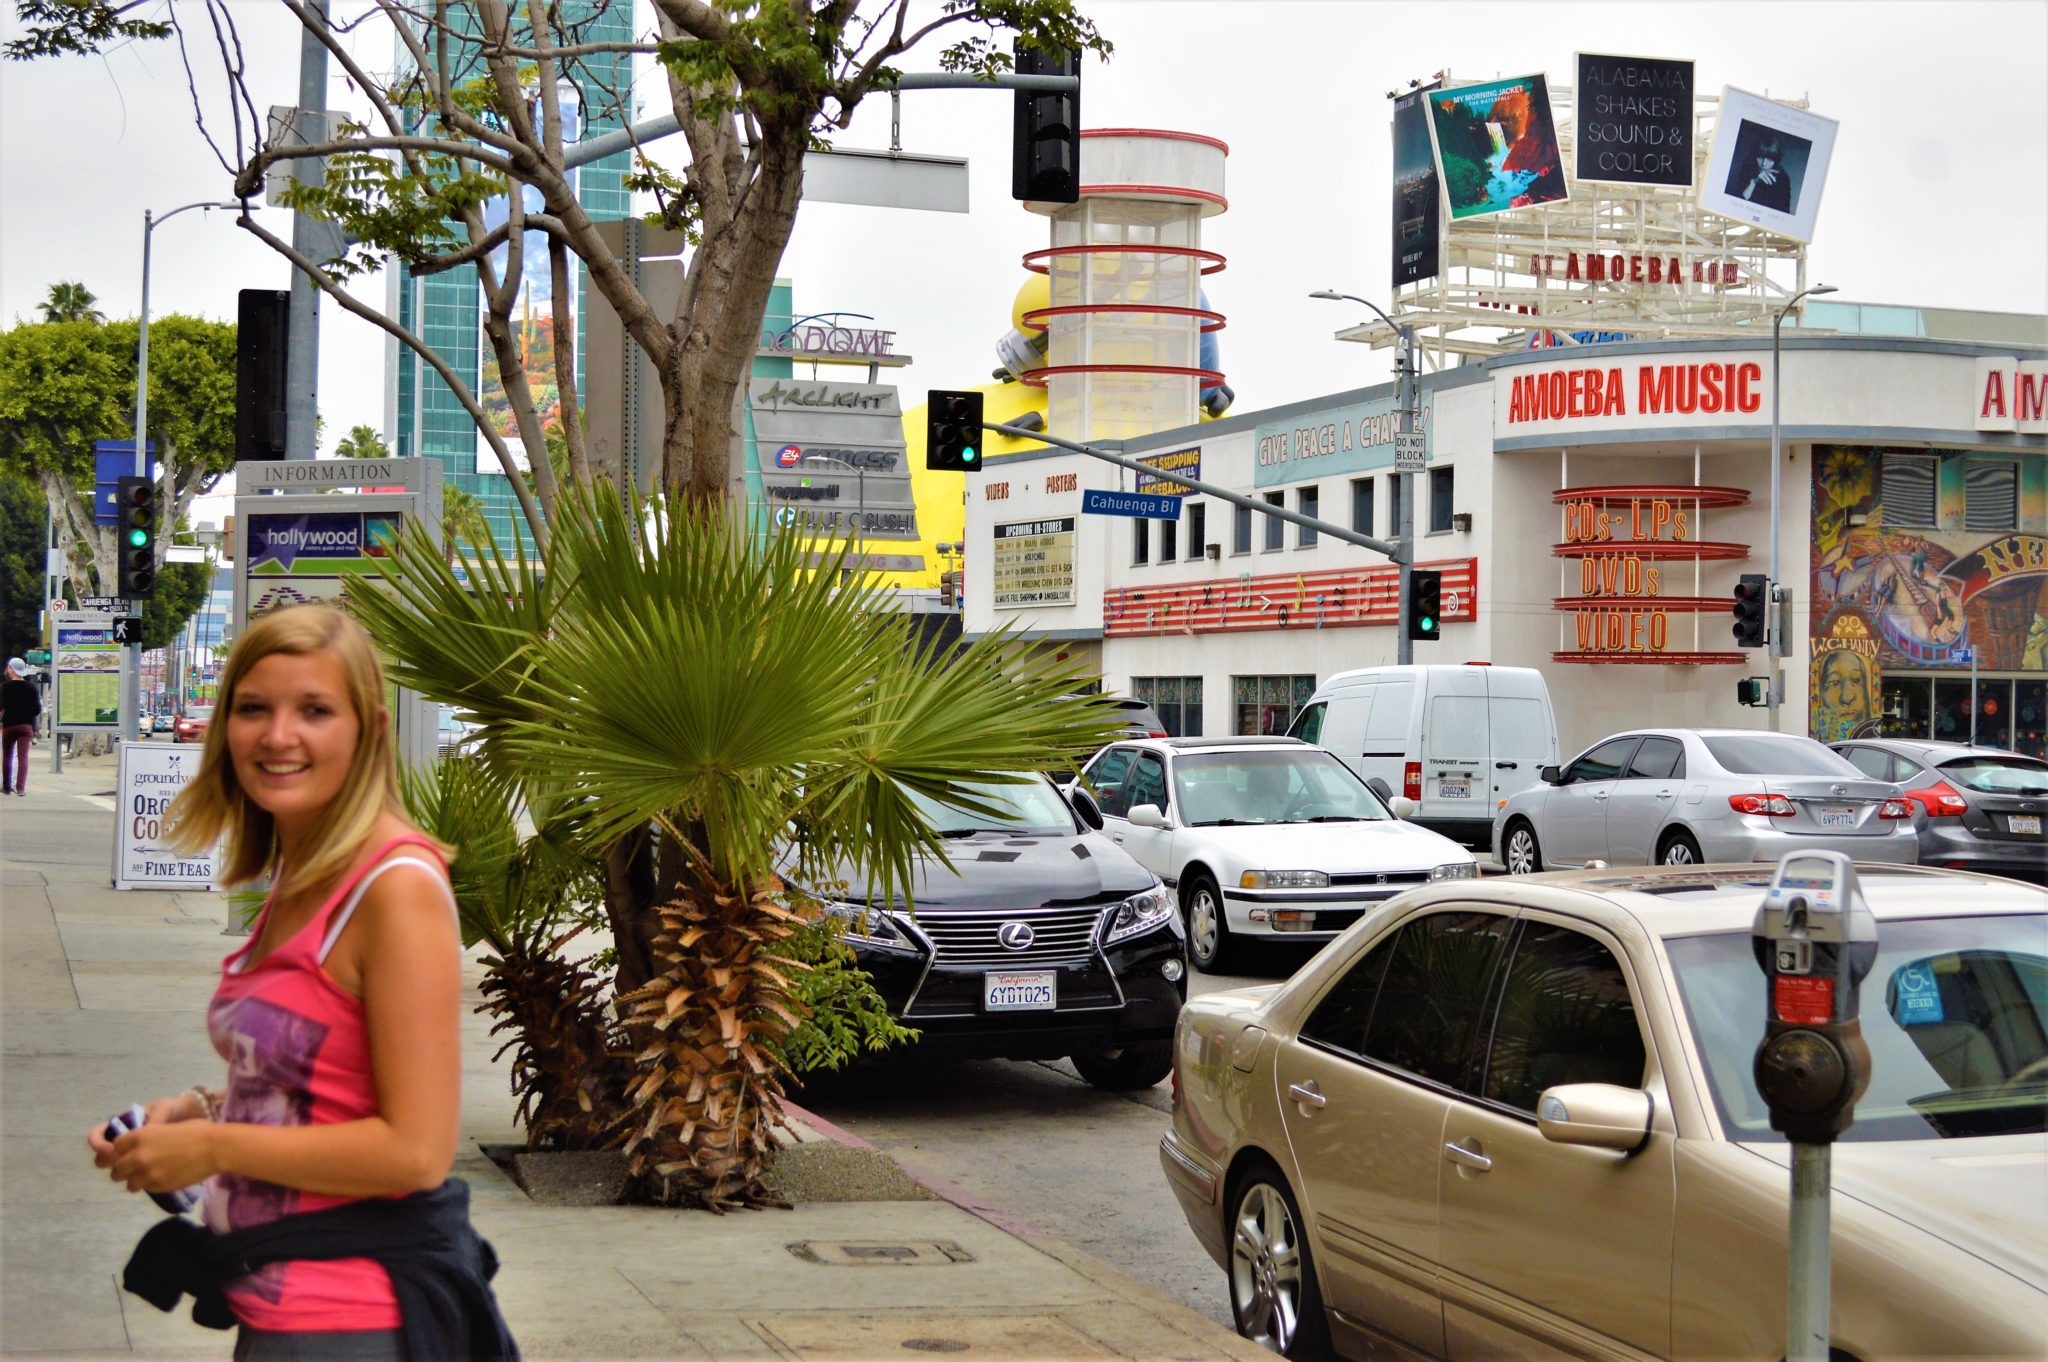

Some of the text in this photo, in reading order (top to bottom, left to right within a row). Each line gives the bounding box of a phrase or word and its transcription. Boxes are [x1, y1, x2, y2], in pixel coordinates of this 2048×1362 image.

[1586, 66, 1685, 90] ALABAMA
[1453, 85, 1524, 104] MY MORNING JACKET
[1595, 94, 1676, 118] SHAKES
[1588, 123, 1683, 146] SOUND &
[1598, 152, 1674, 174] COLOR
[1566, 252, 1682, 284] AMOEBA
[1692, 261, 1738, 284] NOW
[1508, 362, 1762, 424] AMOEBA MUSIC
[1258, 406, 1431, 467] GIVE PEACE A CHANE!
[1396, 438, 1424, 447] DO NOT
[782, 449, 800, 461] 24
[1159, 450, 1199, 470] SHIPPING
[1396, 450, 1424, 460] BLOCK
[265, 464, 392, 482] INFORMATION
[985, 473, 1077, 501] VIDEOS POSTERS
[1090, 495, 1174, 515] Cahuenga Bl
[865, 512, 915, 531] SUSHI
[1005, 520, 1063, 537] UPCOMING IN-STORES
[267, 527, 357, 551] hollywood
[1581, 557, 1660, 596] DVDs
[82, 598, 112, 606] CAHUENGA
[1020, 592, 1037, 602] SHIPPING
[66, 634, 103, 643] hollywood
[1575, 612, 1668, 652] VIDEO
[134, 771, 196, 787] groundw
[134, 794, 171, 816] ORG
[1822, 814, 1853, 825] 6VPY774
[145, 861, 176, 876] FINE
[177, 862, 211, 877] TEAS
[999, 975, 1041, 986] California
[990, 985, 1050, 1004] 6YDT025
